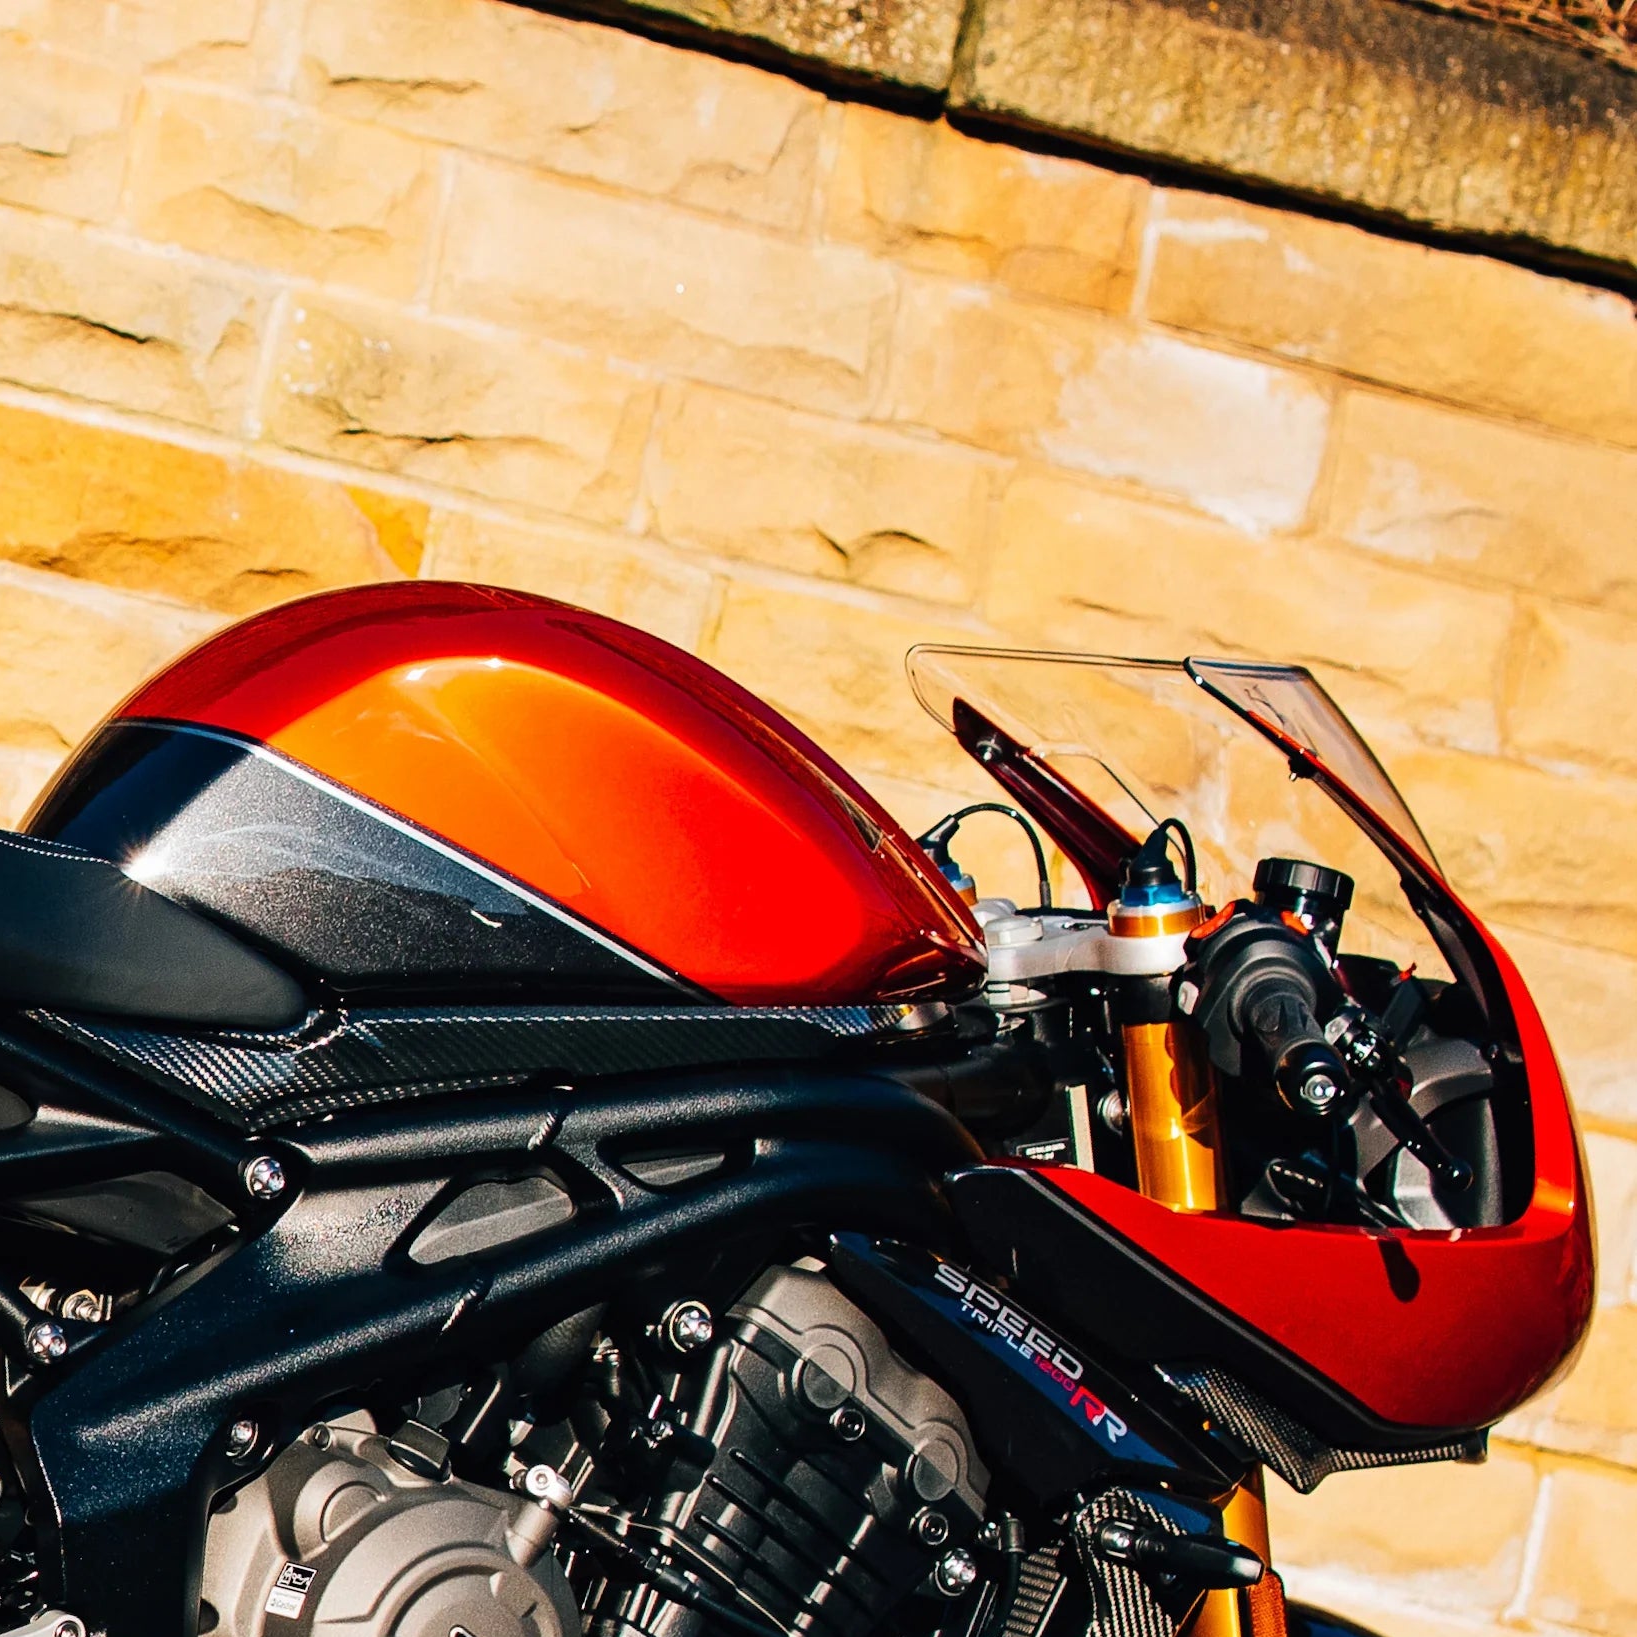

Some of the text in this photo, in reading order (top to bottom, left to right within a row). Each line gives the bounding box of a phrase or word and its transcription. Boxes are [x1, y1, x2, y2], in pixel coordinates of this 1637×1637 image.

[934, 1263, 1084, 1381] SPEED
[960, 1298, 1034, 1360] TRIPLE
[1033, 1354, 1076, 1392] 1200
